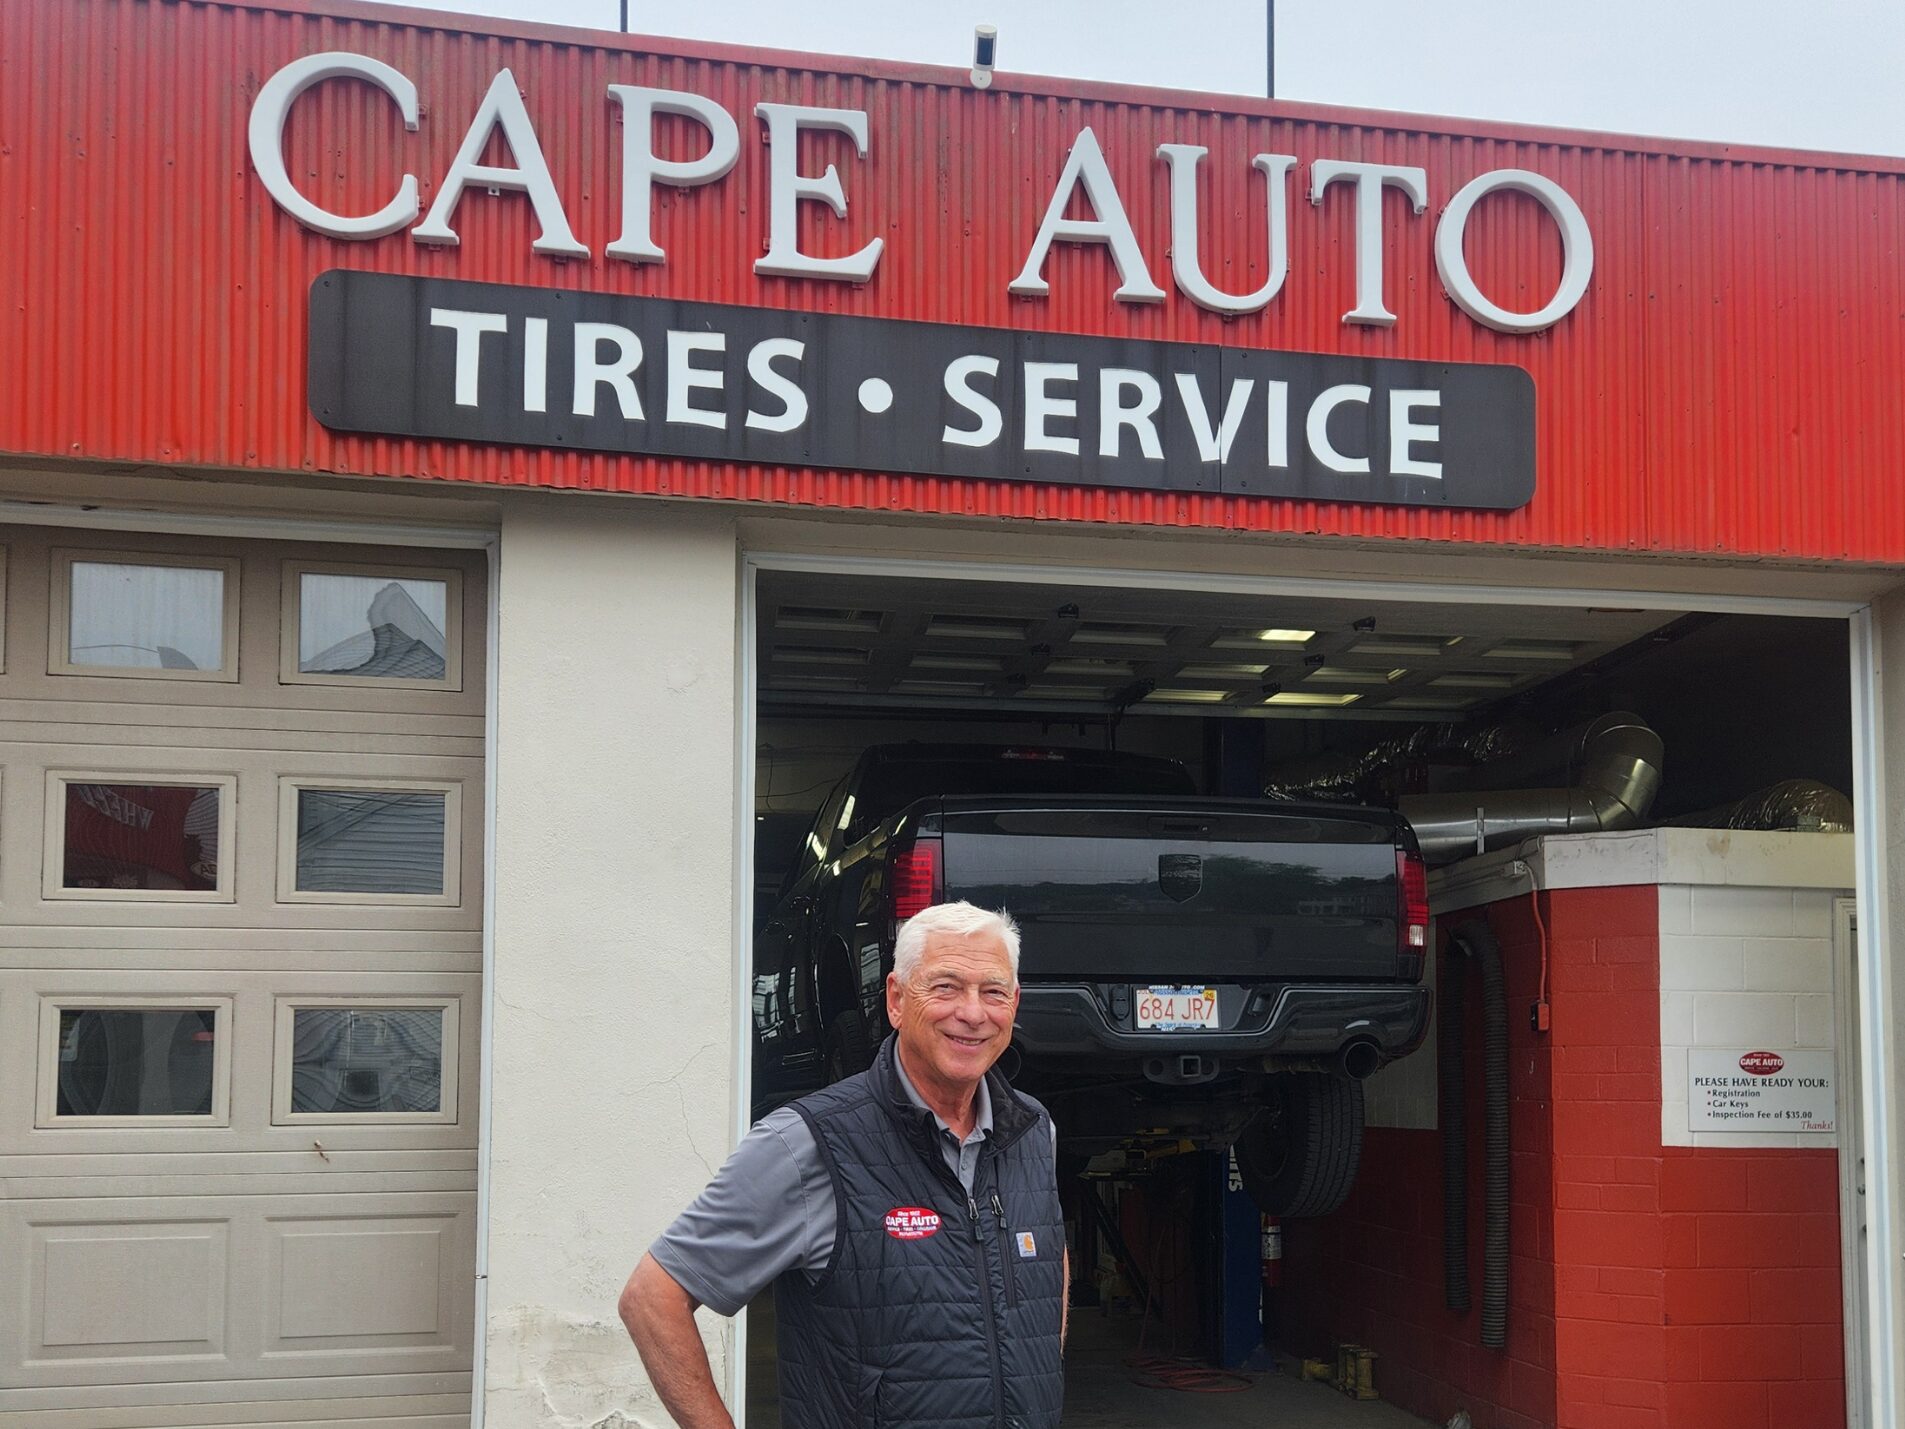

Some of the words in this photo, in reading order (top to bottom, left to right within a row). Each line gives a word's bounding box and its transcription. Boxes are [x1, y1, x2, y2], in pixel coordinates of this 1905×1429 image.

[249, 52, 884, 283] CAPE
[1007, 126, 1594, 334] AUTO
[430, 307, 808, 433] TIRES
[942, 355, 1443, 479] SERVICE
[1140, 998, 1174, 1020] 684
[1182, 998, 1215, 1020] JR7
[1740, 1058, 1761, 1066] CAPE
[1762, 1058, 1783, 1066] AUTO
[1695, 1078, 1728, 1087] PLEASE
[1732, 1078, 1757, 1087] HAVE
[1761, 1078, 1794, 1087] READY
[1798, 1078, 1829, 1088] YOUR:
[1712, 1089, 1760, 1098] Registration
[1712, 1099, 1726, 1108] Car
[1730, 1100, 1749, 1109] Keys
[1712, 1111, 1754, 1119] Inspection
[1757, 1111, 1771, 1119] Fee
[1774, 1111, 1783, 1119] of
[1786, 1111, 1812, 1119] $35.00
[1801, 1121, 1833, 1130] Thanks!
[885, 1216, 909, 1226] CAPE
[911, 1215, 938, 1226] AUTO
